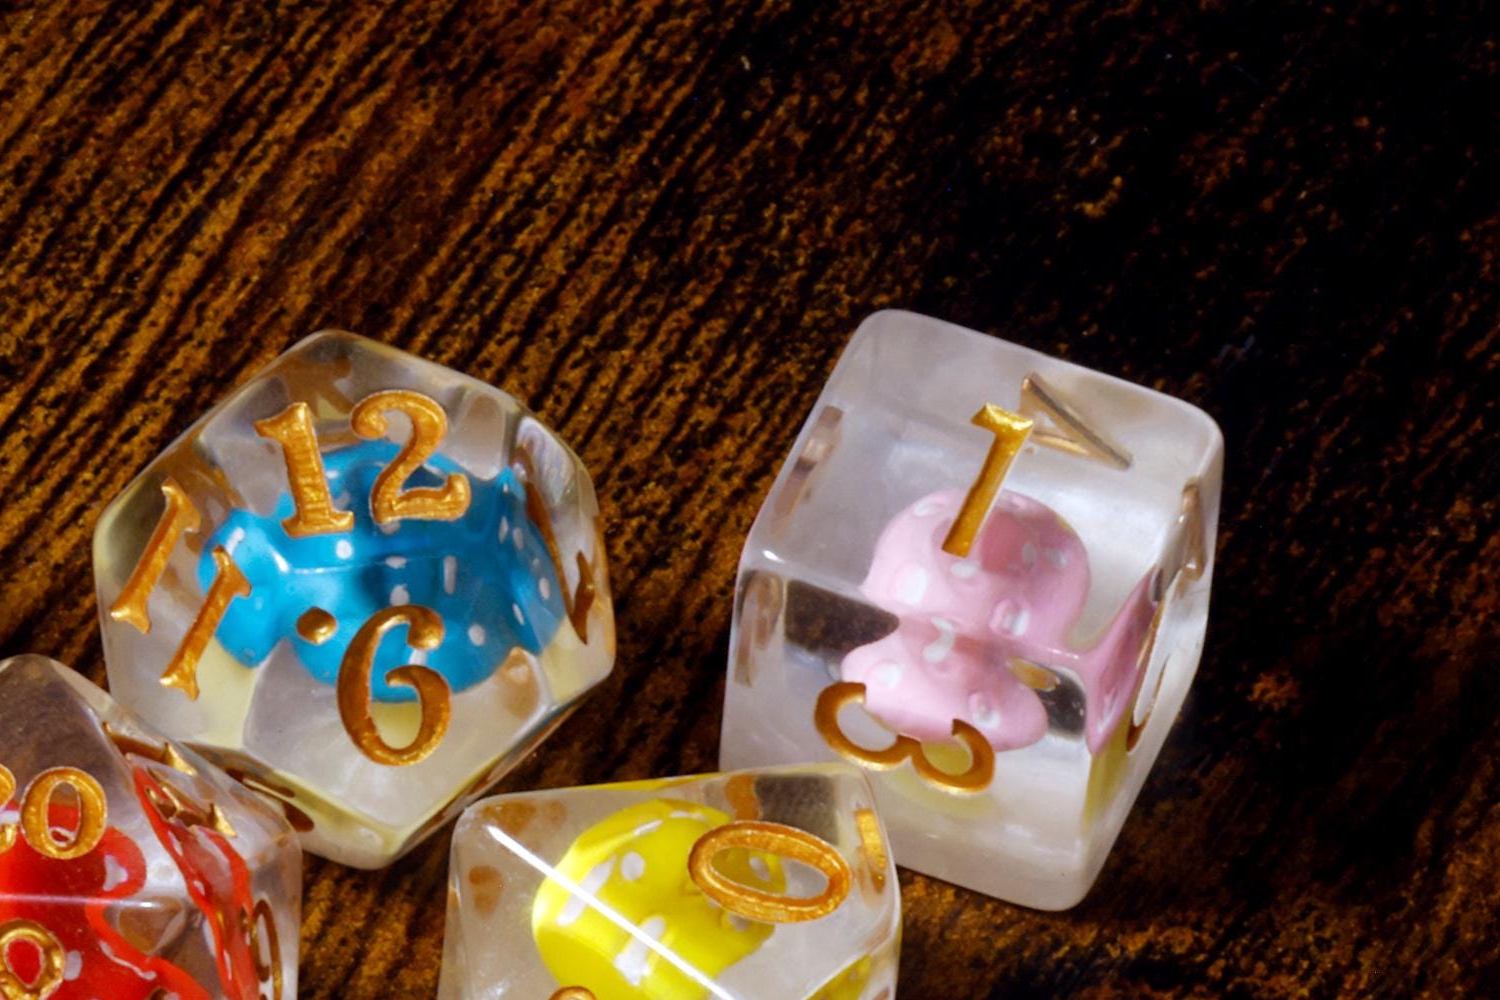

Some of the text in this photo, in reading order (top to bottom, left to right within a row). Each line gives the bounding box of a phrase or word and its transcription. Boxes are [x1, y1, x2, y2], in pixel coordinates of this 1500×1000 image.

[254, 389, 472, 538] 12
[941, 402, 1034, 558] 1
[110, 477, 252, 700] 11
[814, 681, 996, 794] 3
[687, 820, 852, 924] 0
